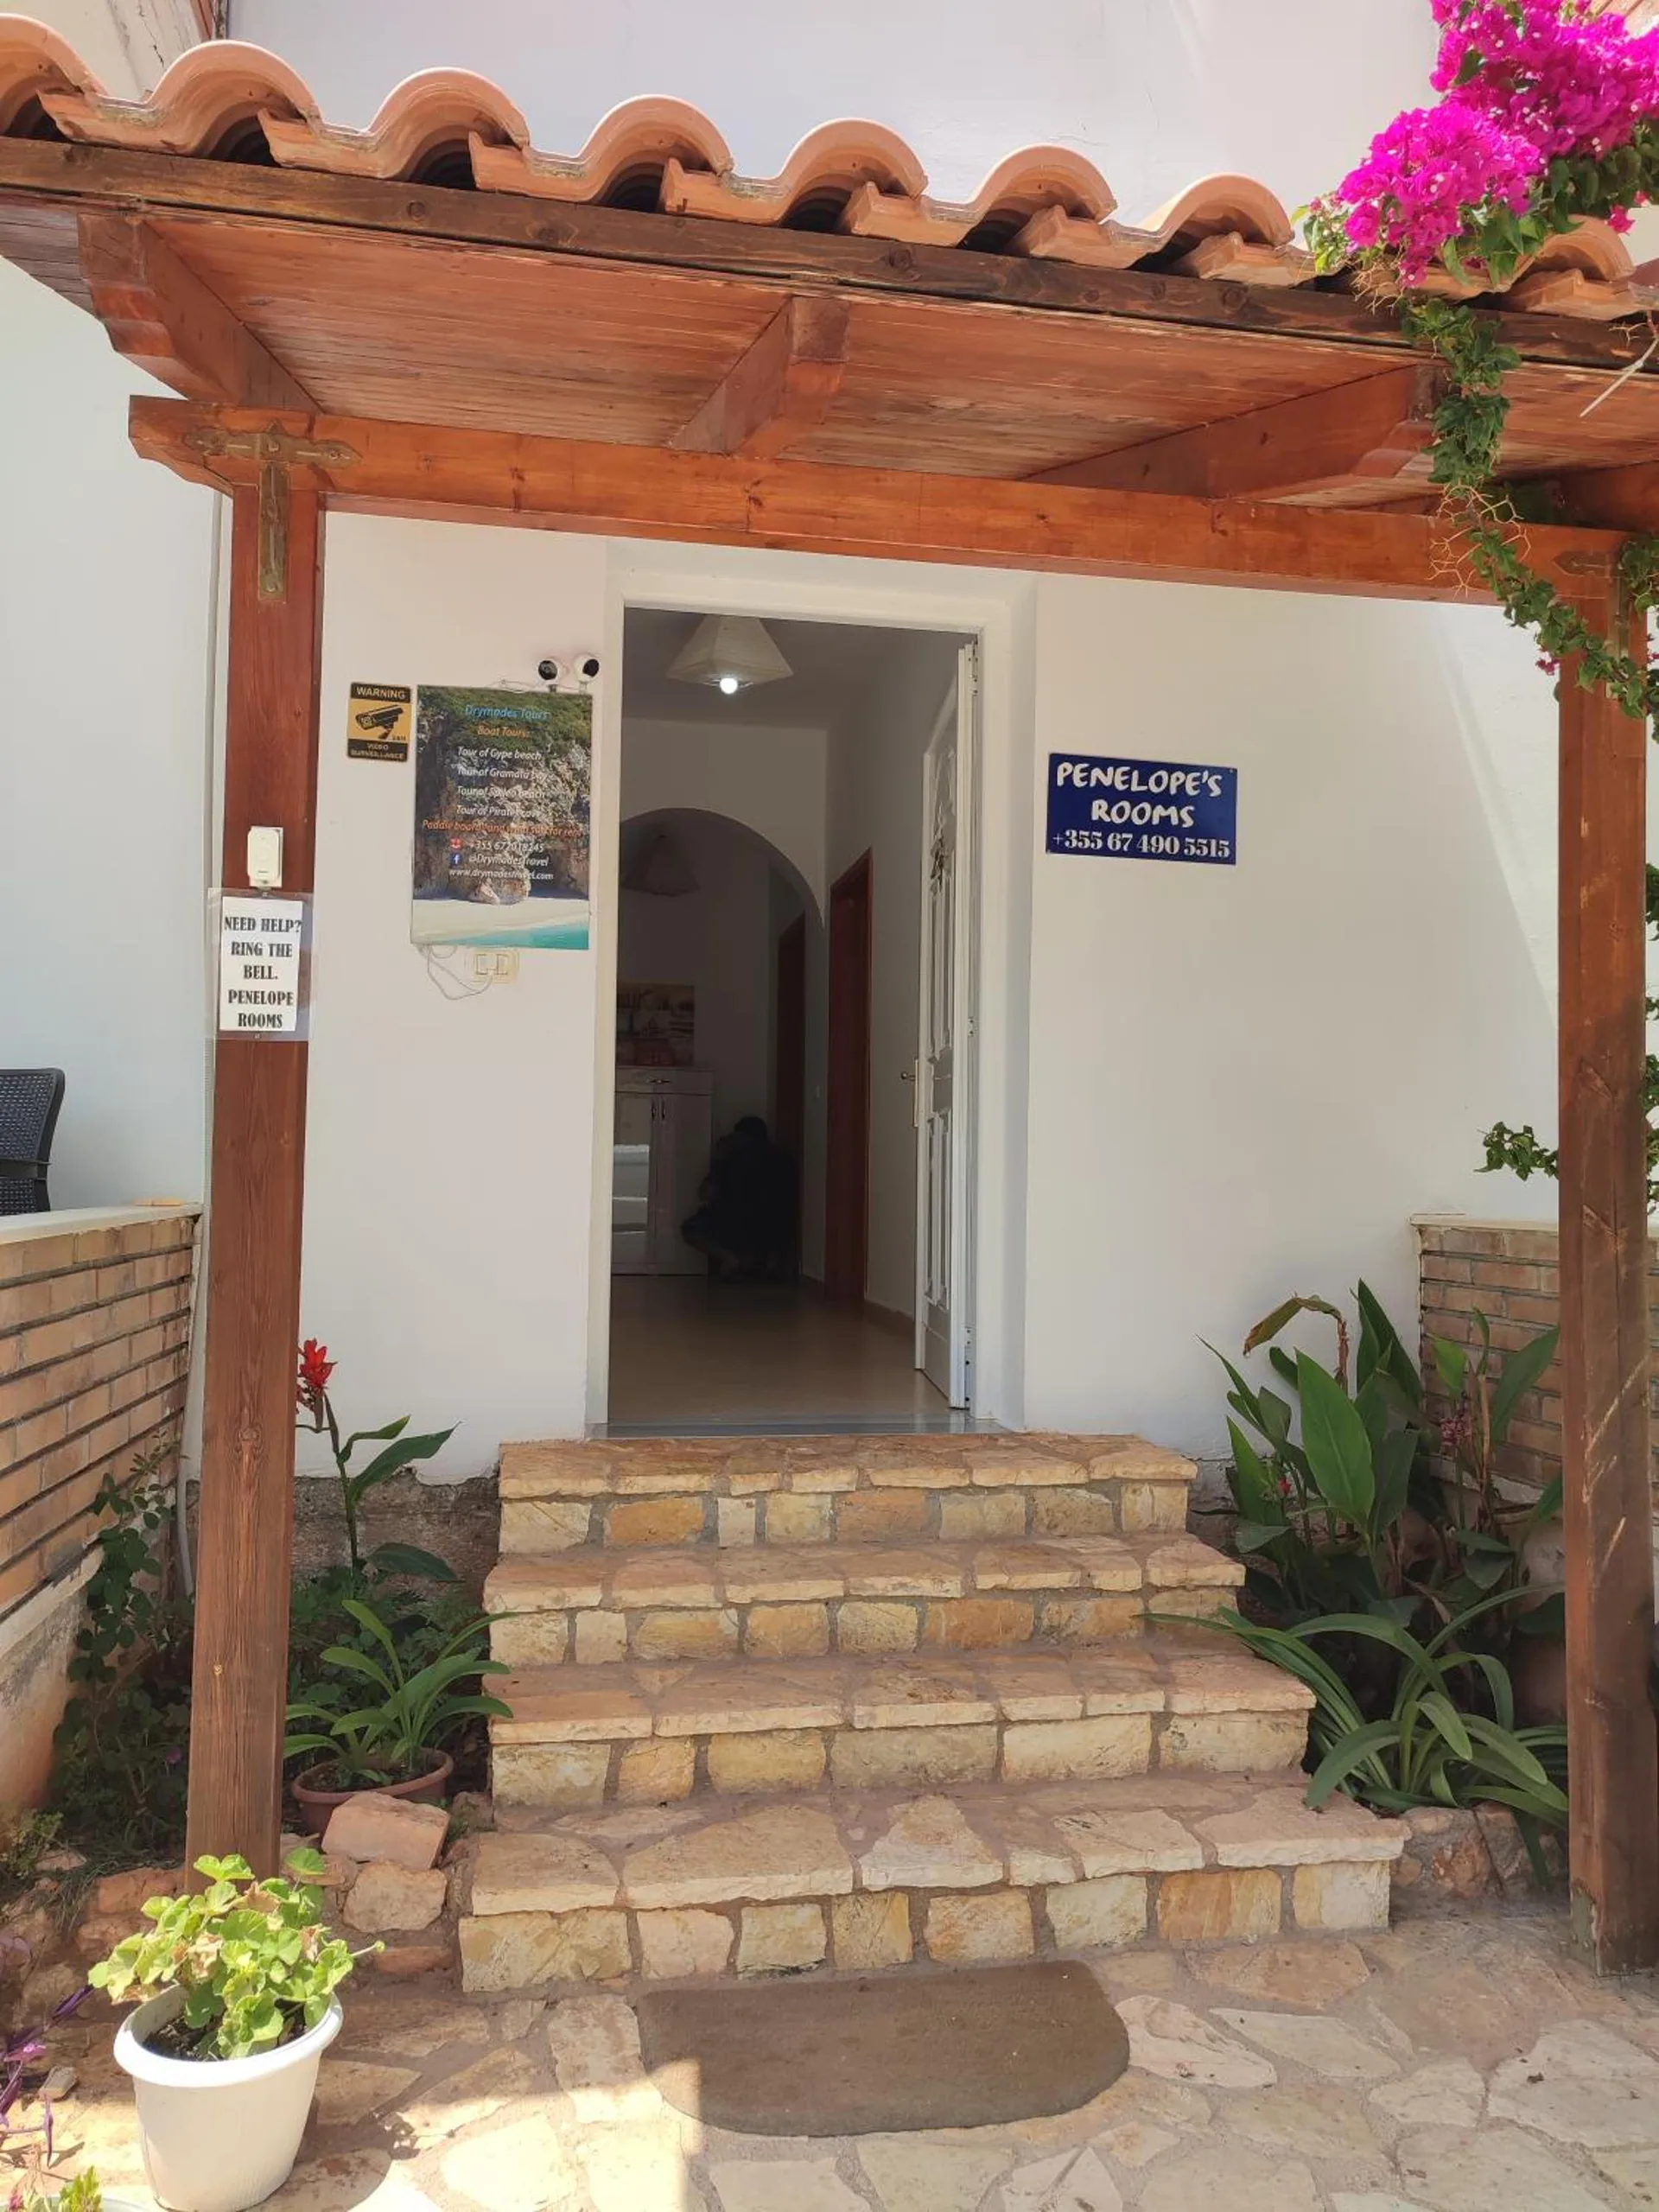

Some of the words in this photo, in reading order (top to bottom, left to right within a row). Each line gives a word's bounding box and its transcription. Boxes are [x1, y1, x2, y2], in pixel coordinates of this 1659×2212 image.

[356, 686, 405, 699] WARNING
[519, 707, 549, 721] Tours
[477, 725, 499, 736] Boat
[351, 749, 404, 760] SURVEILLANCE
[458, 746, 476, 756] Tour
[479, 747, 490, 757] of
[490, 748, 512, 760] Gype
[514, 749, 541, 760] beach
[457, 765, 478, 776] Tour
[479, 766, 490, 776] of
[1056, 761, 1223, 798] PENELOPE'S
[457, 785, 477, 796] Tour
[477, 785, 487, 798] of
[518, 787, 545, 798] beach
[456, 804, 476, 815] Tour
[477, 805, 488, 816] of
[1091, 798, 1195, 828] ROOMS
[423, 819, 453, 830] Paddle
[1052, 830, 1103, 849] +355
[1107, 832, 1133, 852] 67
[1136, 834, 1179, 855] 490
[1184, 838, 1230, 858] 5515
[225, 916, 256, 932] NEED
[261, 917, 302, 934] HELP?
[231, 941, 263, 957] RING
[268, 943, 293, 958] THE
[244, 964, 278, 980] BELL.
[227, 989, 294, 1006] PENELOPE
[238, 1013, 283, 1028] ROOMS
